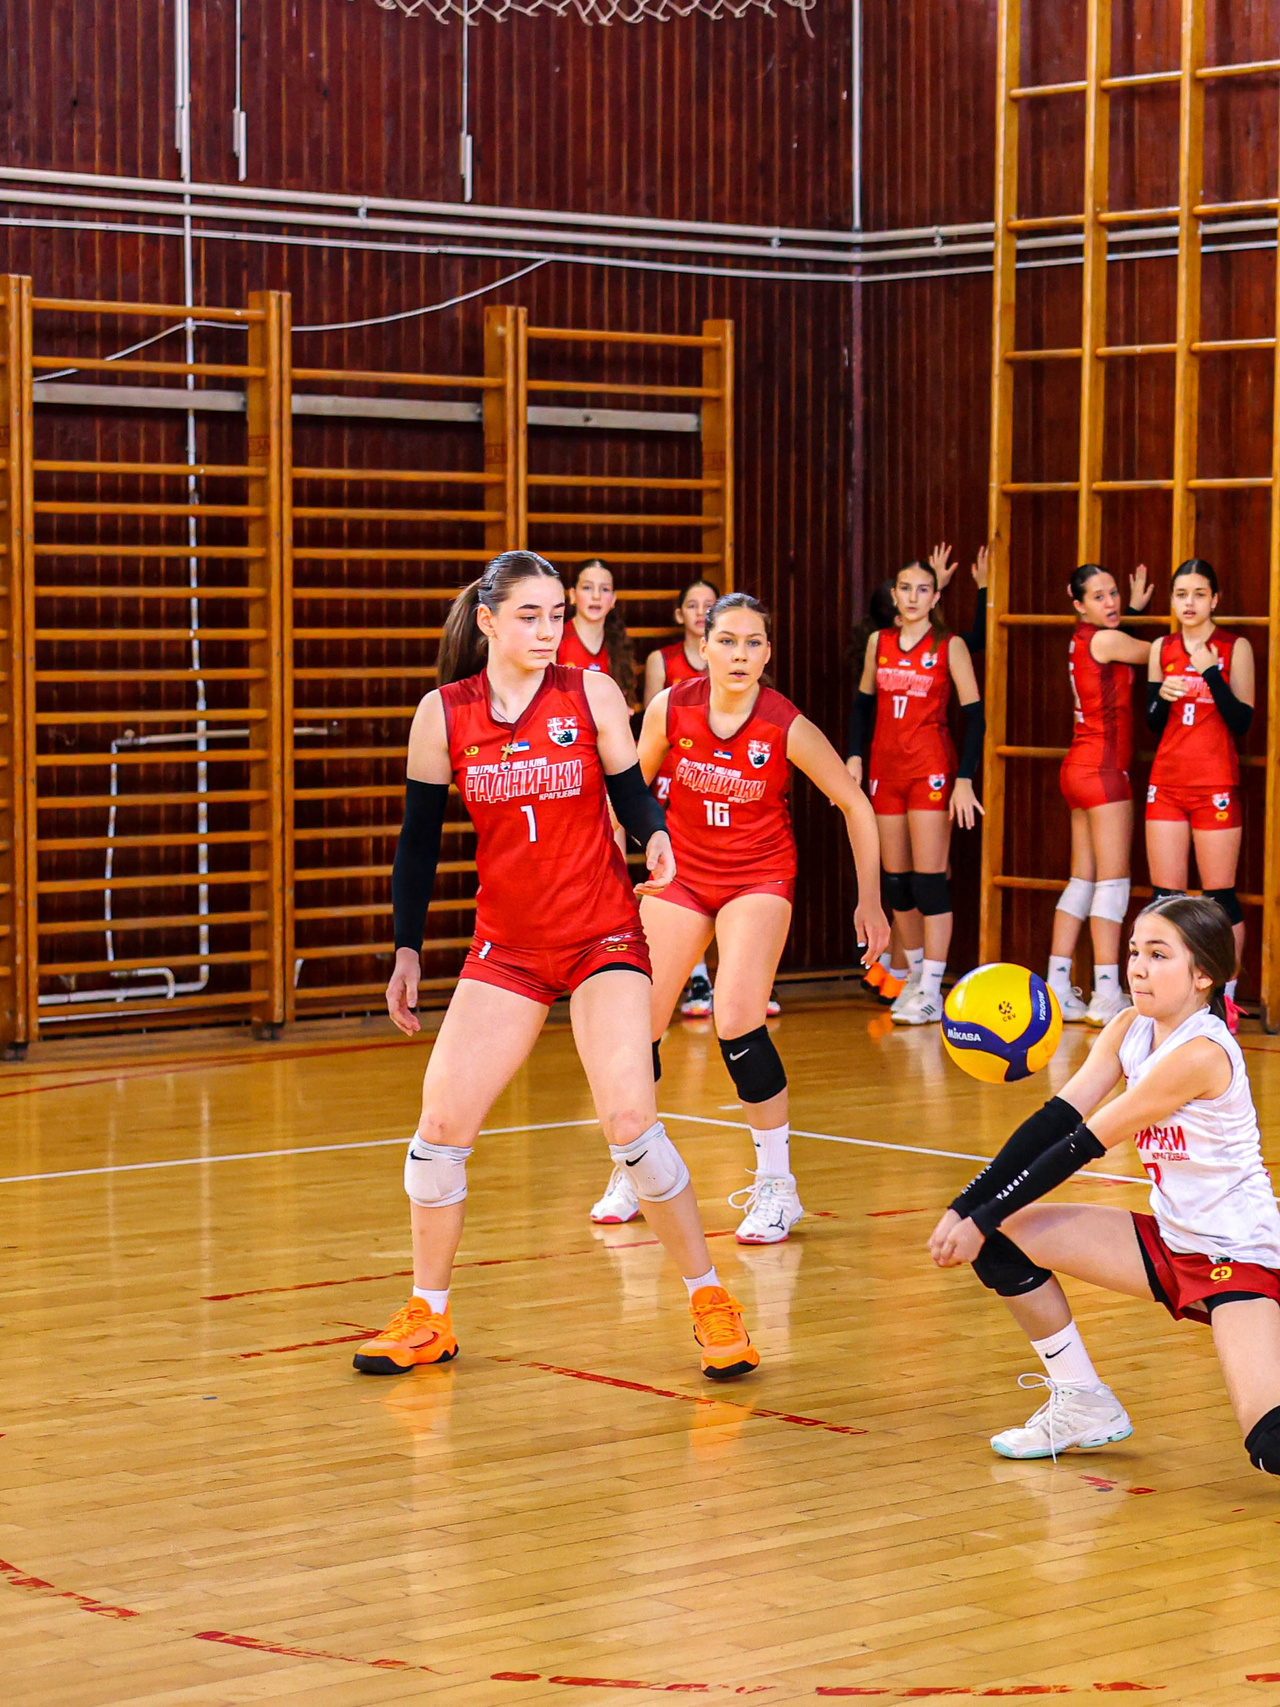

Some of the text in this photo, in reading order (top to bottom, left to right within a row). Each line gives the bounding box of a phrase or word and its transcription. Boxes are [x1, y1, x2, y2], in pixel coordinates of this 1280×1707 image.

[892, 695, 908, 719] 17
[1182, 703, 1195, 726] 8
[466, 759, 583, 804] РАДНИЧКИ
[676, 763, 767, 795] РАДНИЧКИ
[520, 805, 537, 842] 1
[703, 800, 730, 827] 16
[1002, 1013, 1017, 1022] CEV
[1036, 990, 1047, 1021] V200W
